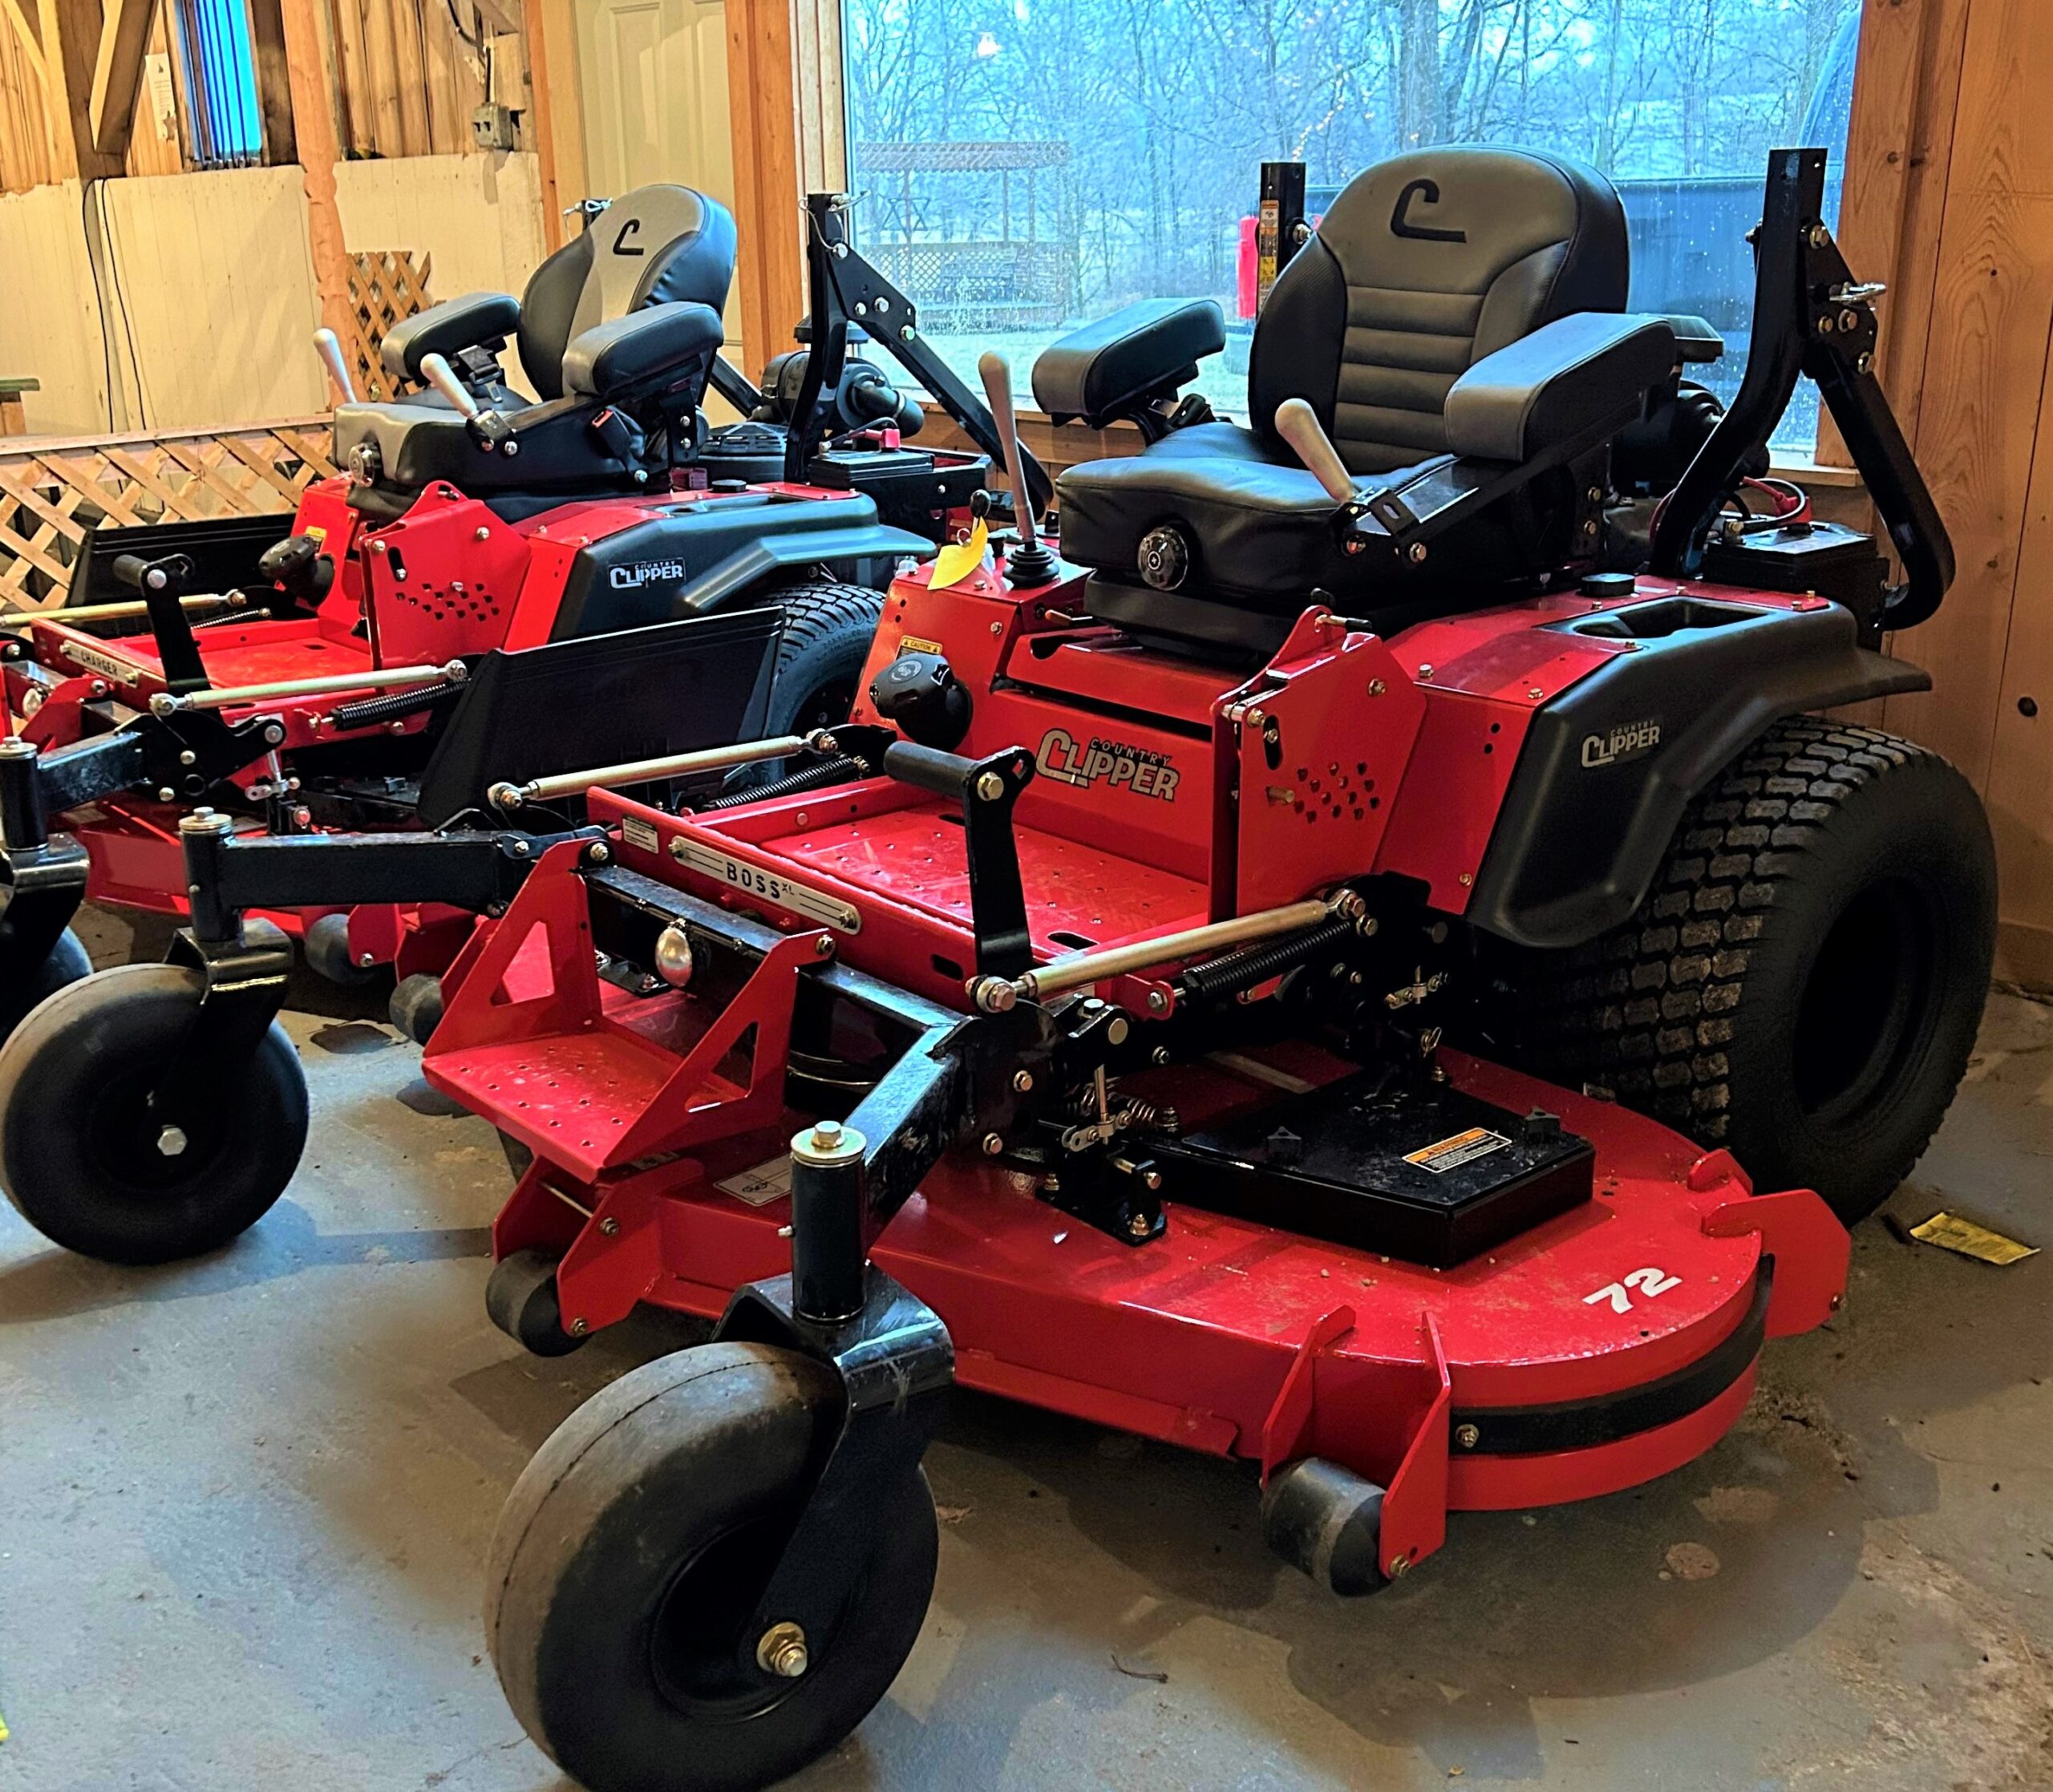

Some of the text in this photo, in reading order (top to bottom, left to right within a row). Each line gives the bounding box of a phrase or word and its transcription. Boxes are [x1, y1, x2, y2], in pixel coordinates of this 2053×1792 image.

[609, 564, 683, 589] CLIPPER
[634, 560, 675, 571] COUNTRY
[1036, 729, 1180, 801] CLIPPER
[1091, 738, 1171, 767] COUNTRY
[1581, 726, 1661, 767] CLIPPER
[727, 862, 780, 900] BOSS
[1581, 1268, 1682, 1314] 72
